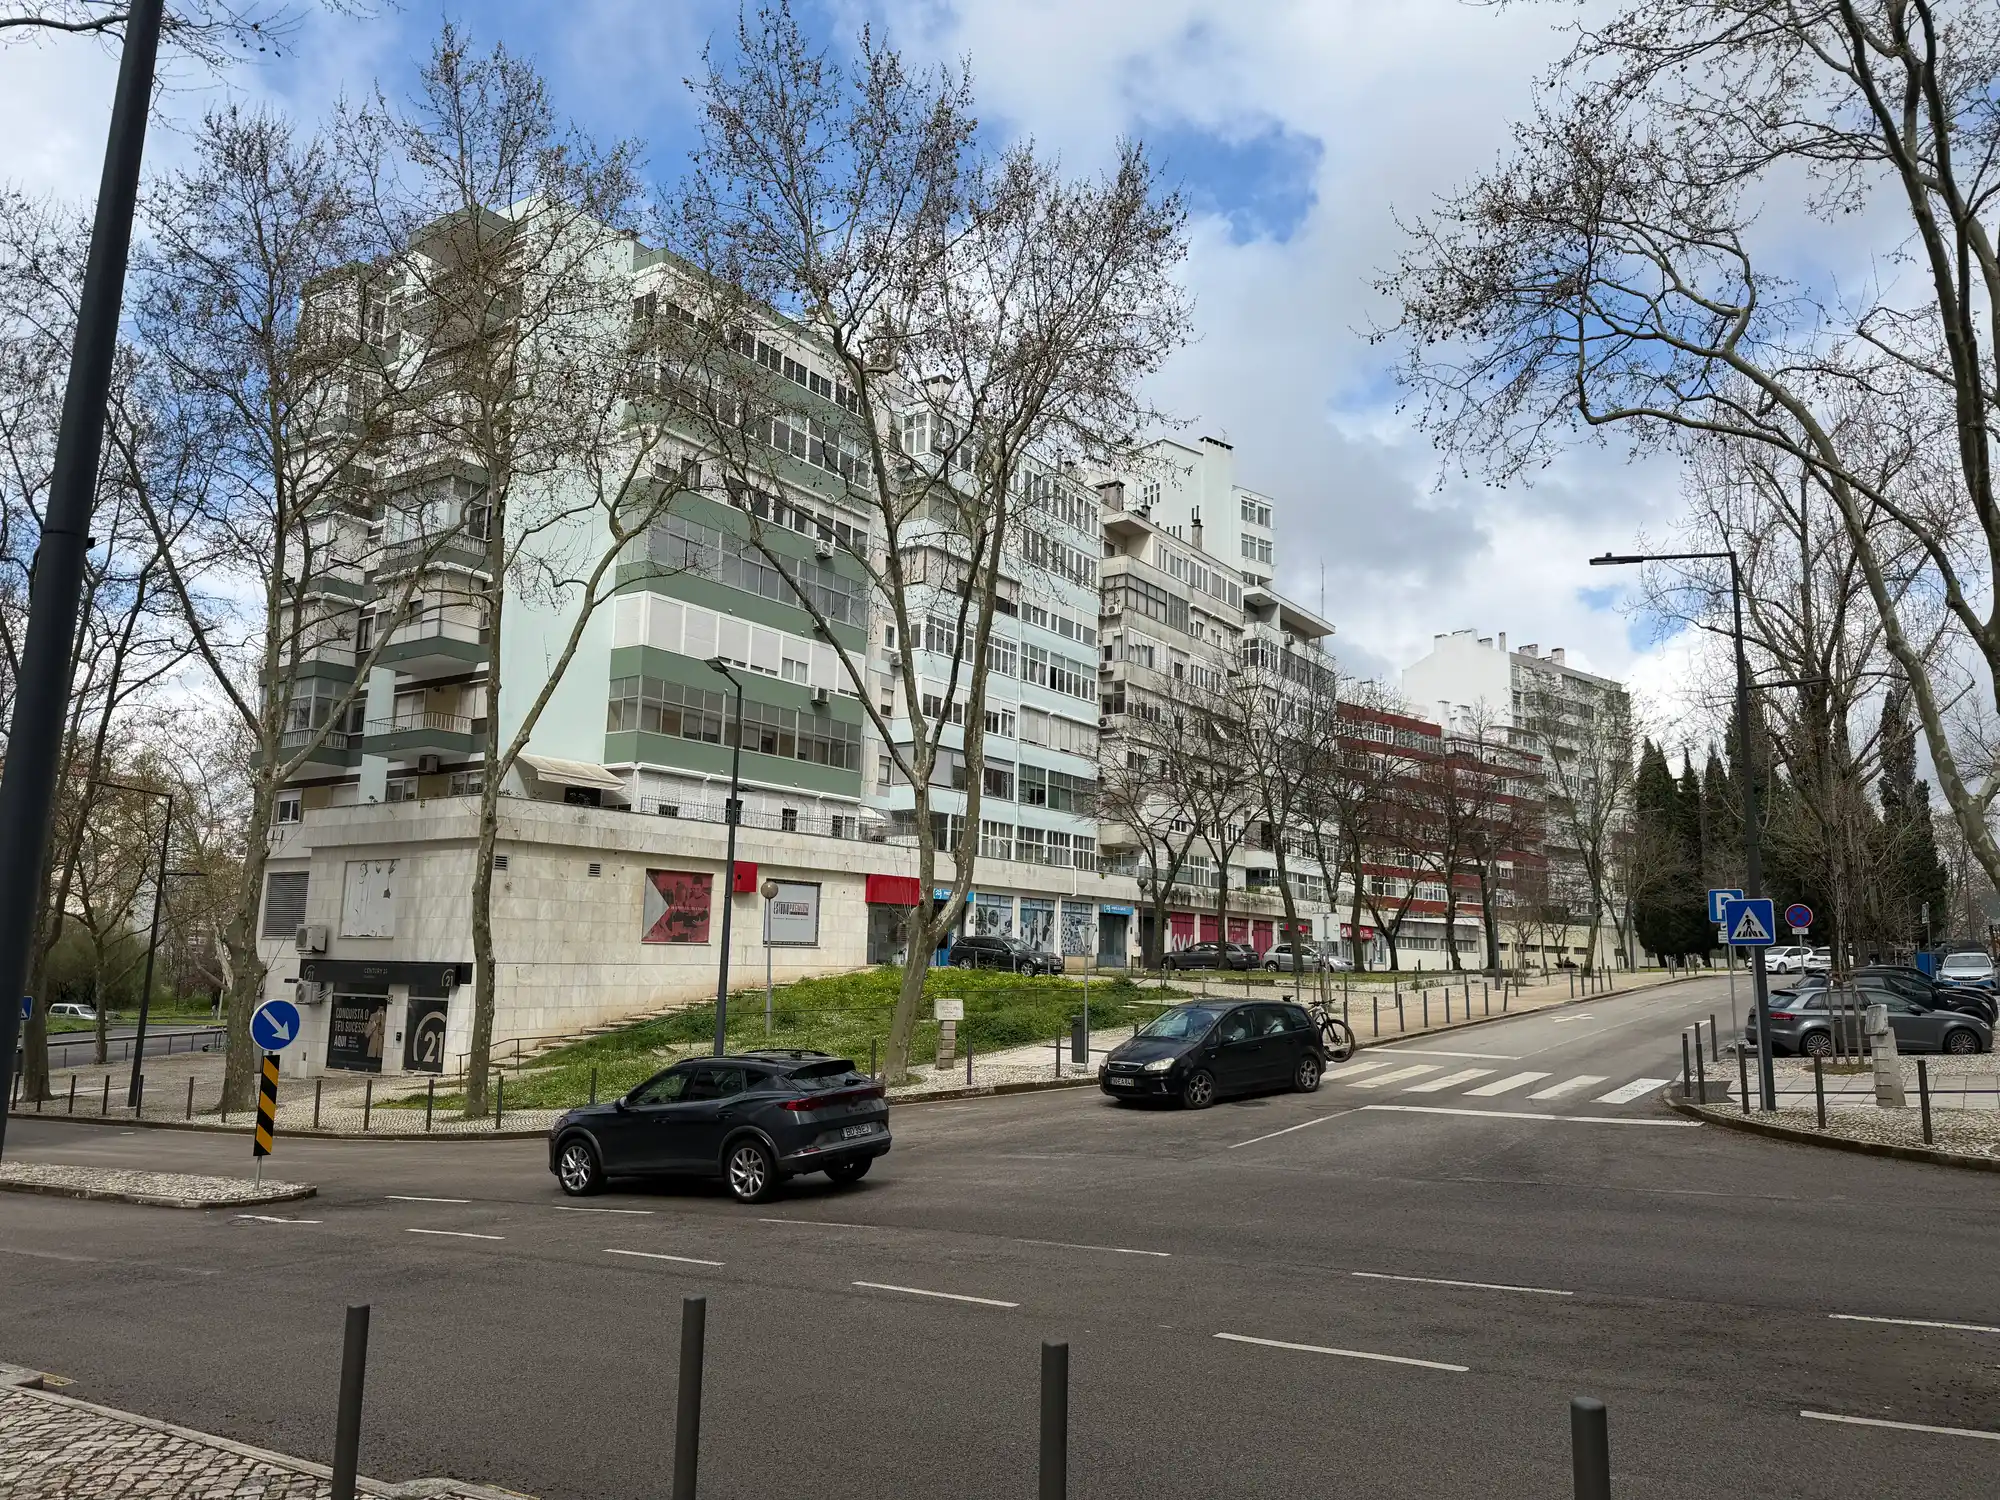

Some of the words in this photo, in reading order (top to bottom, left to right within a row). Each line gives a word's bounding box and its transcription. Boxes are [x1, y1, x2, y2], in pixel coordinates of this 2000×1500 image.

[1715, 892, 1735, 920] P
[336, 1007, 364, 1020] CONQUISTA
[334, 1020, 345, 1032] TEU
[333, 1034, 347, 1048] AQUI
[423, 1031, 444, 1063] 21
